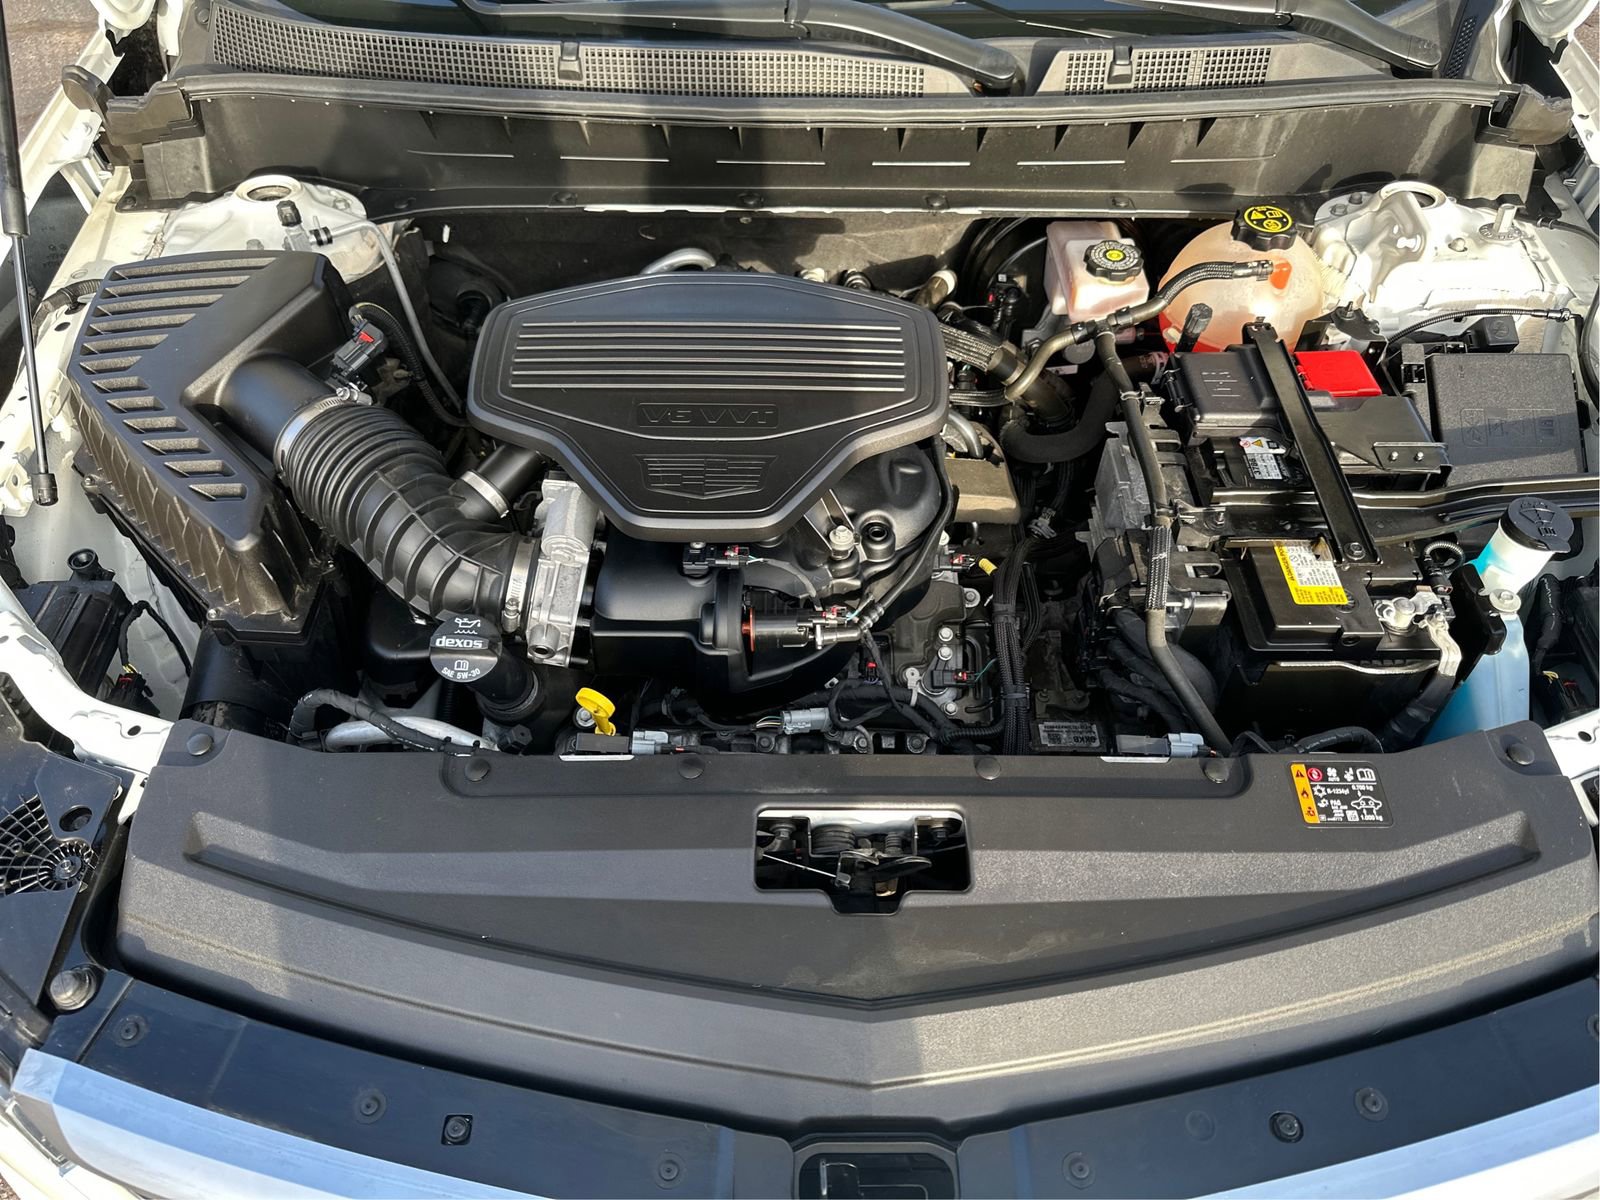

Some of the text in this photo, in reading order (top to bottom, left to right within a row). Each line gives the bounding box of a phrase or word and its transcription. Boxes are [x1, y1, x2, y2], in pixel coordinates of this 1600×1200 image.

[641, 407, 774, 424] V6 VVT
[435, 636, 483, 648] dexos
[441, 666, 481, 679] SAE 5W-30
[1366, 784, 1374, 792] kg
[1376, 814, 1384, 822] kg
